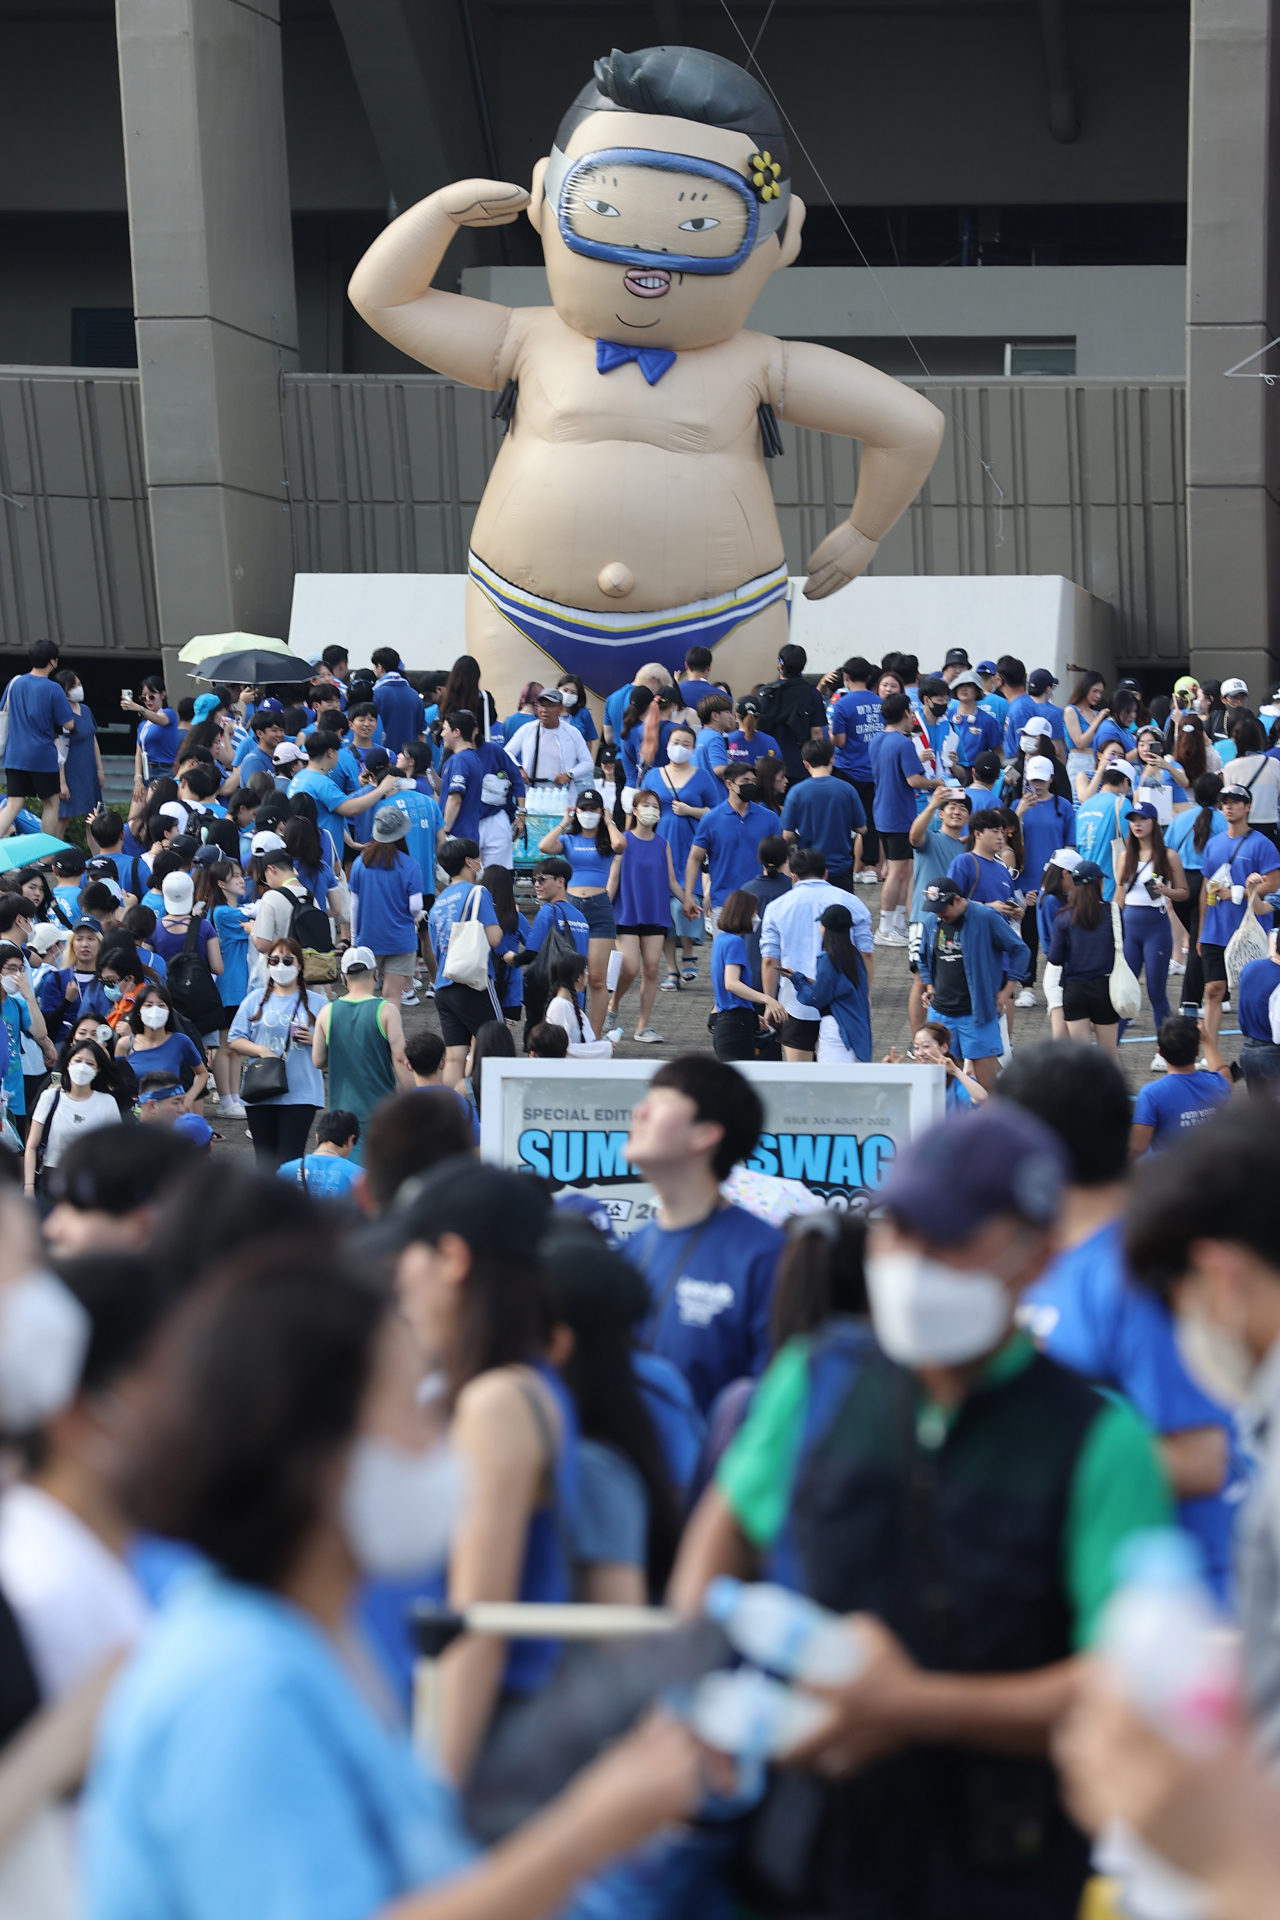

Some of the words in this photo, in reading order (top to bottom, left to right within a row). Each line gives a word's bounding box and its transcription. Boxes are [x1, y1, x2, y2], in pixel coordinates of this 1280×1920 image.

[523, 1108, 590, 1121] SPECIAL
[784, 1116, 808, 1125] ISSUE
[867, 1117, 891, 1126] 2022
[746, 1132, 896, 1191] SWAG
